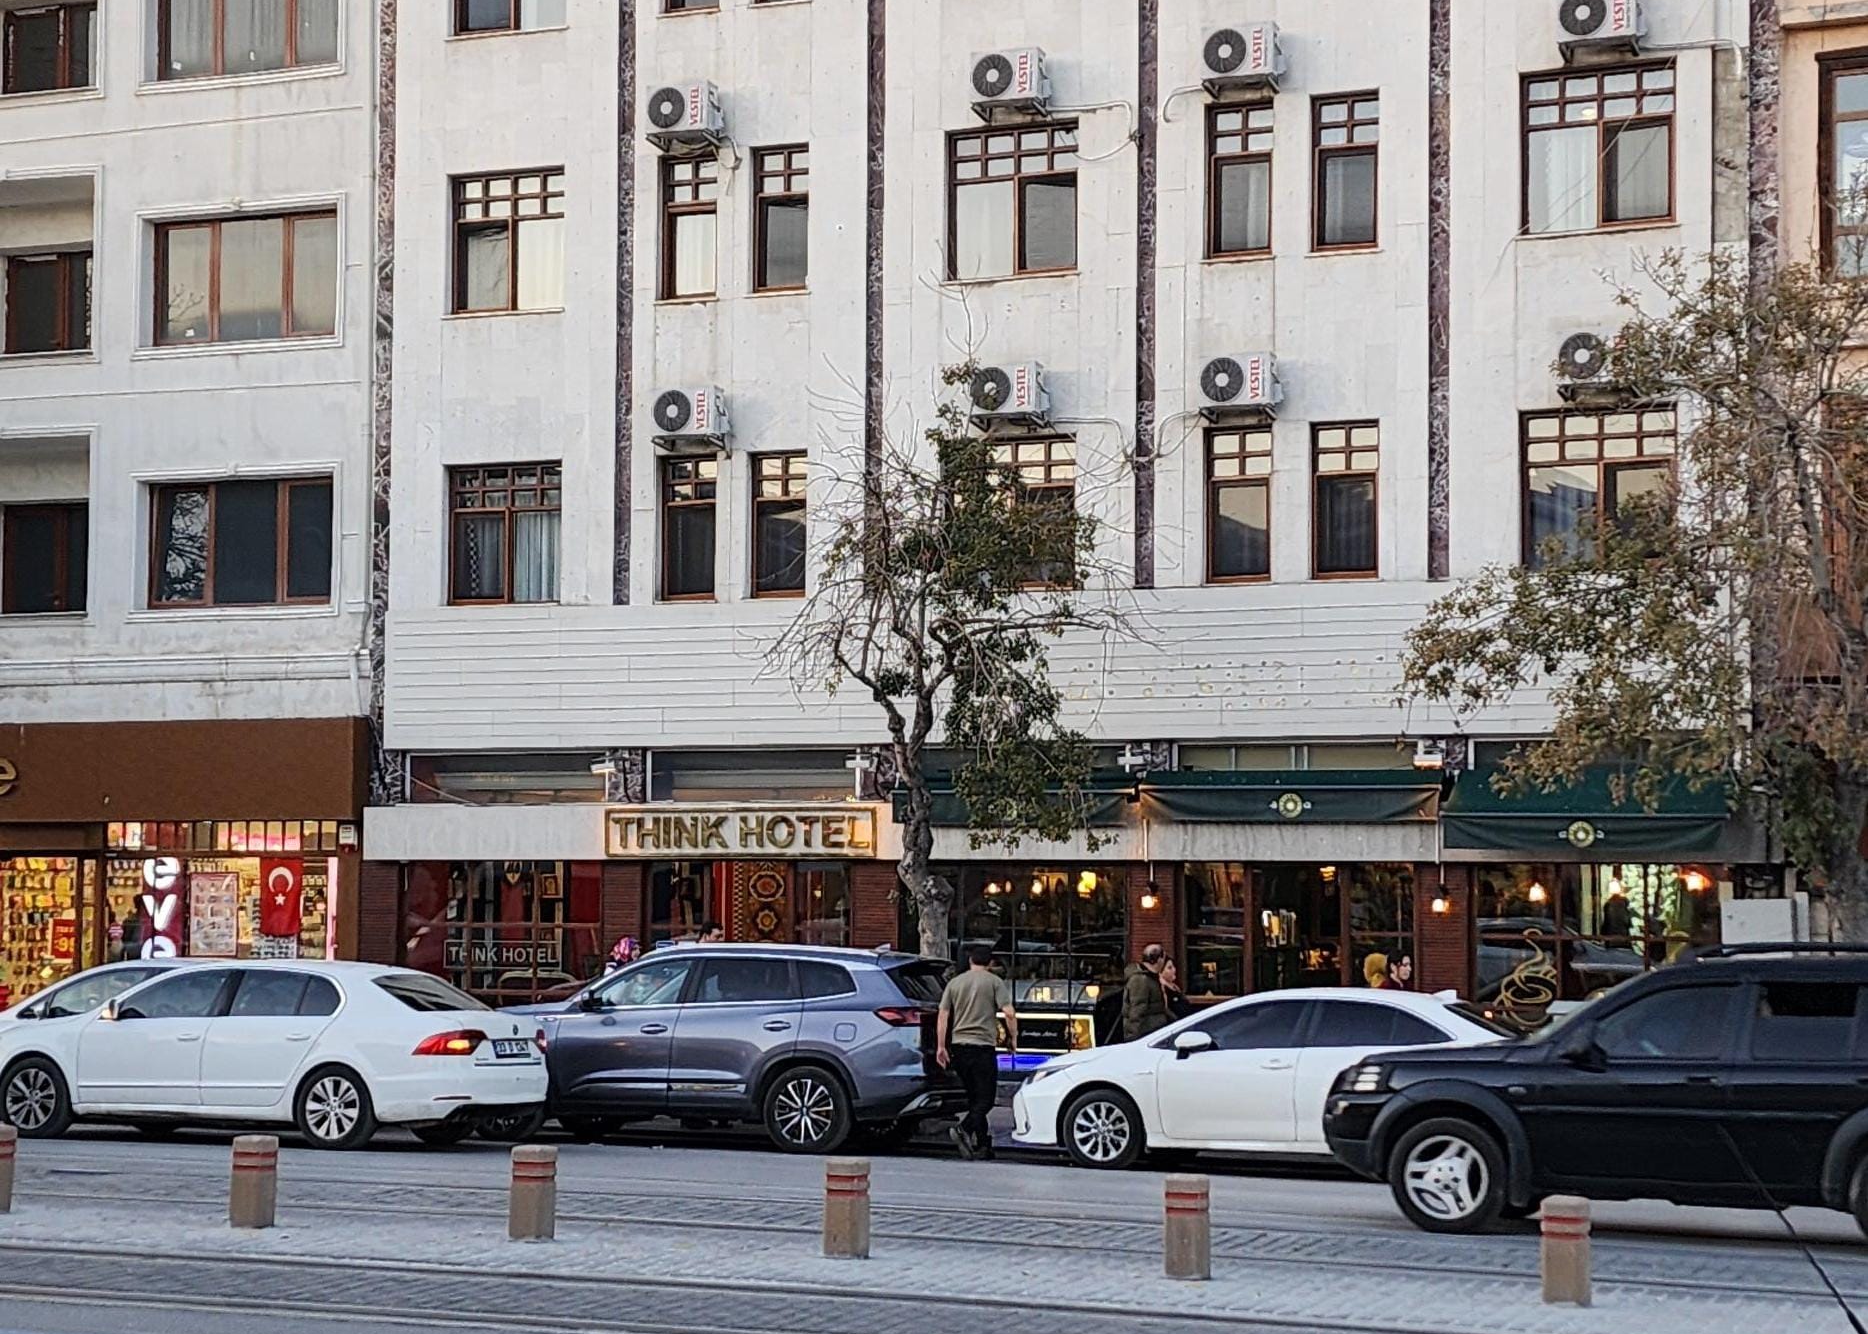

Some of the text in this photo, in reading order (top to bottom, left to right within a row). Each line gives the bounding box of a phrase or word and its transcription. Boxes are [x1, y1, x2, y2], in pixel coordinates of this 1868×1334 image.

[1252, 27, 1264, 69] VESTEL
[1018, 52, 1029, 93] VESTEL
[689, 86, 700, 125] VESTEL
[1016, 367, 1027, 407] VESTEL
[1249, 356, 1261, 399] VESTEL
[695, 390, 706, 429] VESTEL
[611, 815, 870, 849] THINK HOTEL
[502, 947, 559, 963] HOTEL
